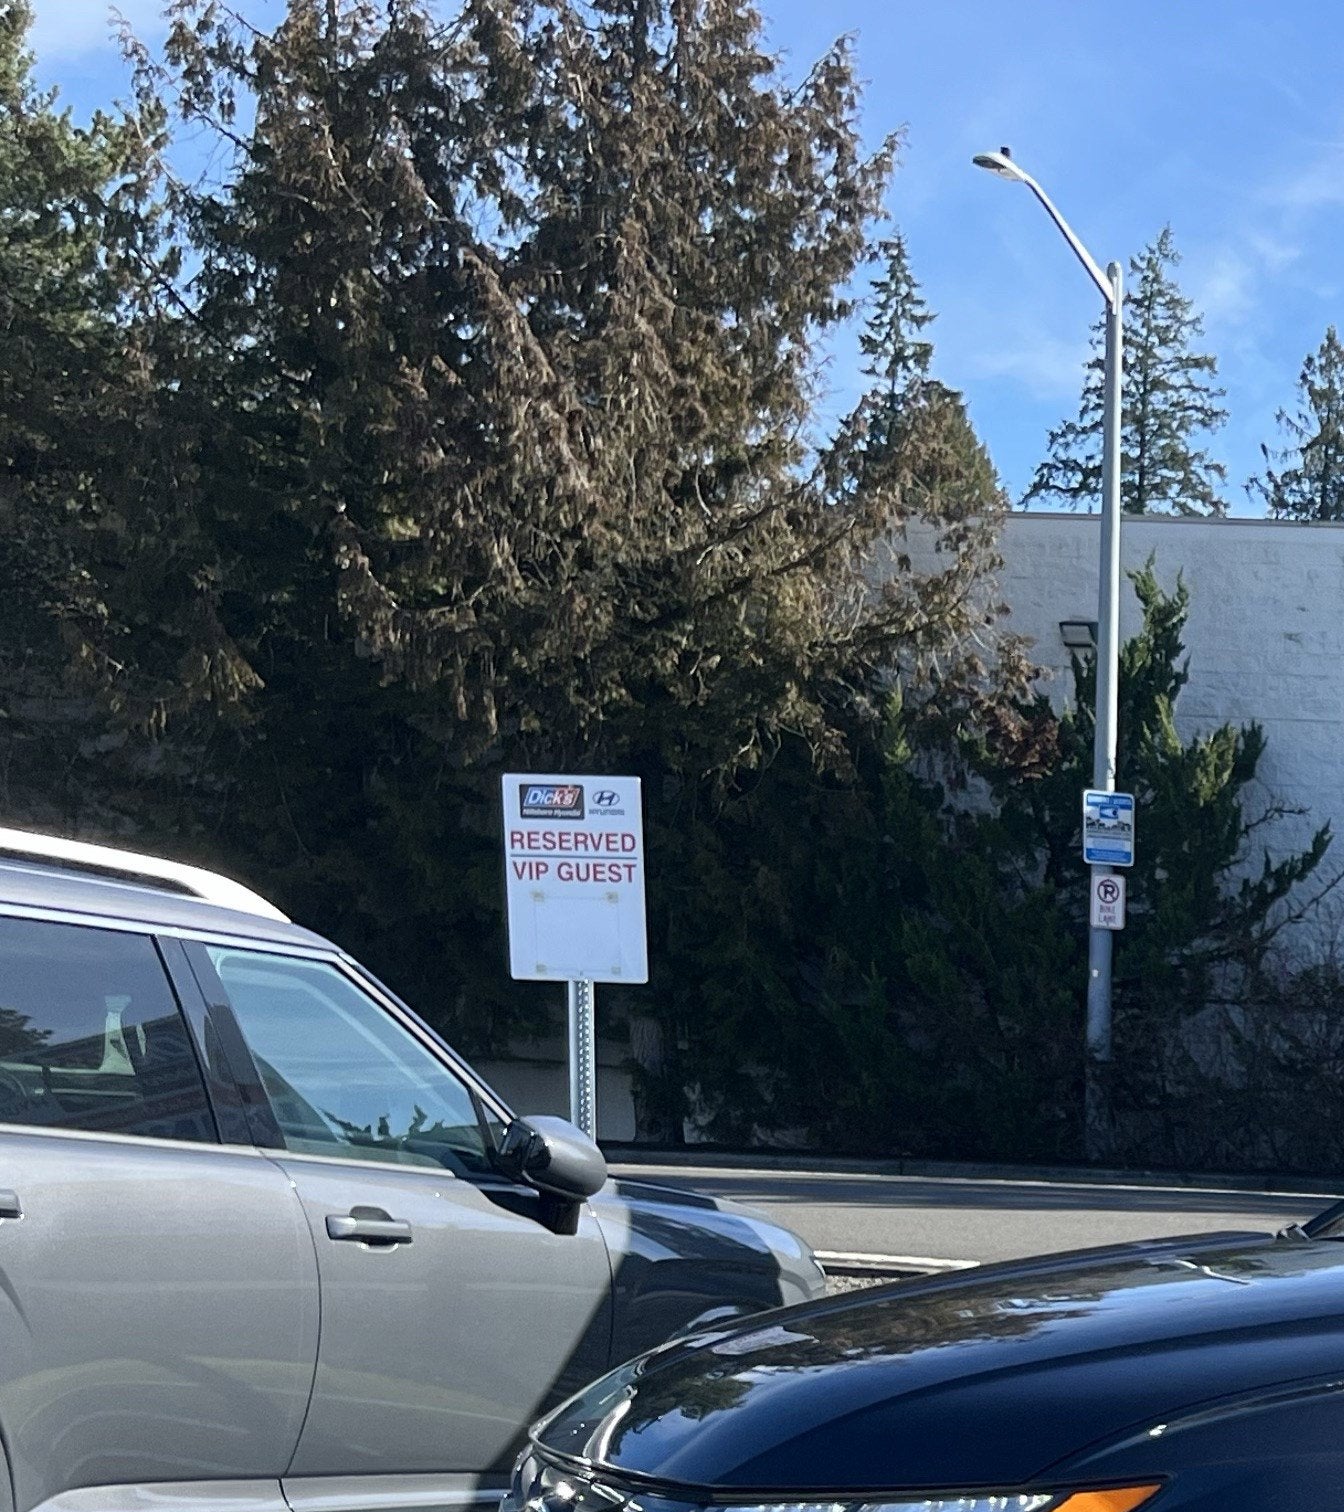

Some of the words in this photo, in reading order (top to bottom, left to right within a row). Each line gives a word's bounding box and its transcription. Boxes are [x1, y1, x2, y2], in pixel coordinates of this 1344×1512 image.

[510, 830, 637, 853] RESERVED
[512, 860, 549, 881] VIP
[557, 862, 638, 884] GUEST
